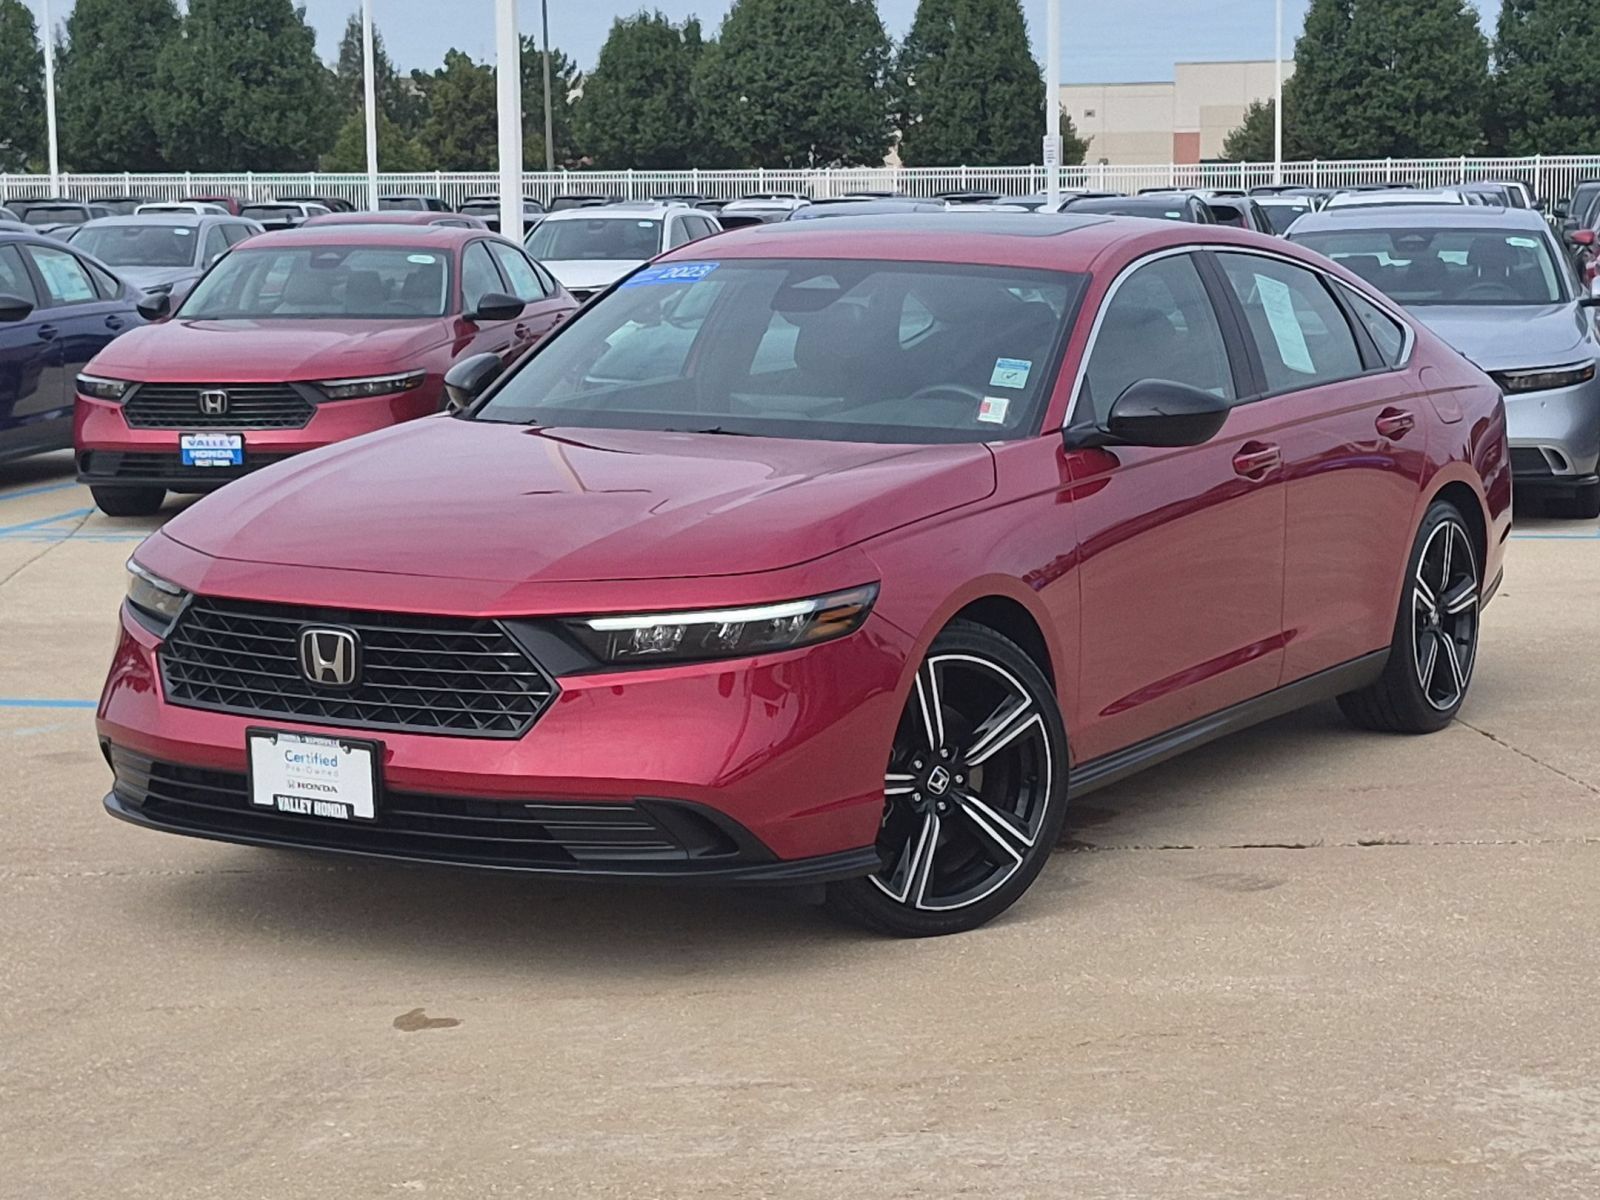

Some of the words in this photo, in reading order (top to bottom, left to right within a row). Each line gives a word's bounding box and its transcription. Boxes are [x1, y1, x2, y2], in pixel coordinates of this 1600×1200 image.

[658, 265, 712, 279] 2023
[188, 439, 236, 447] VALLEY
[189, 450, 234, 459] HONDA
[285, 750, 338, 768] Certified
[297, 781, 338, 793] HONDA
[277, 796, 312, 815] VALLEY
[314, 800, 349, 819] HONDA
